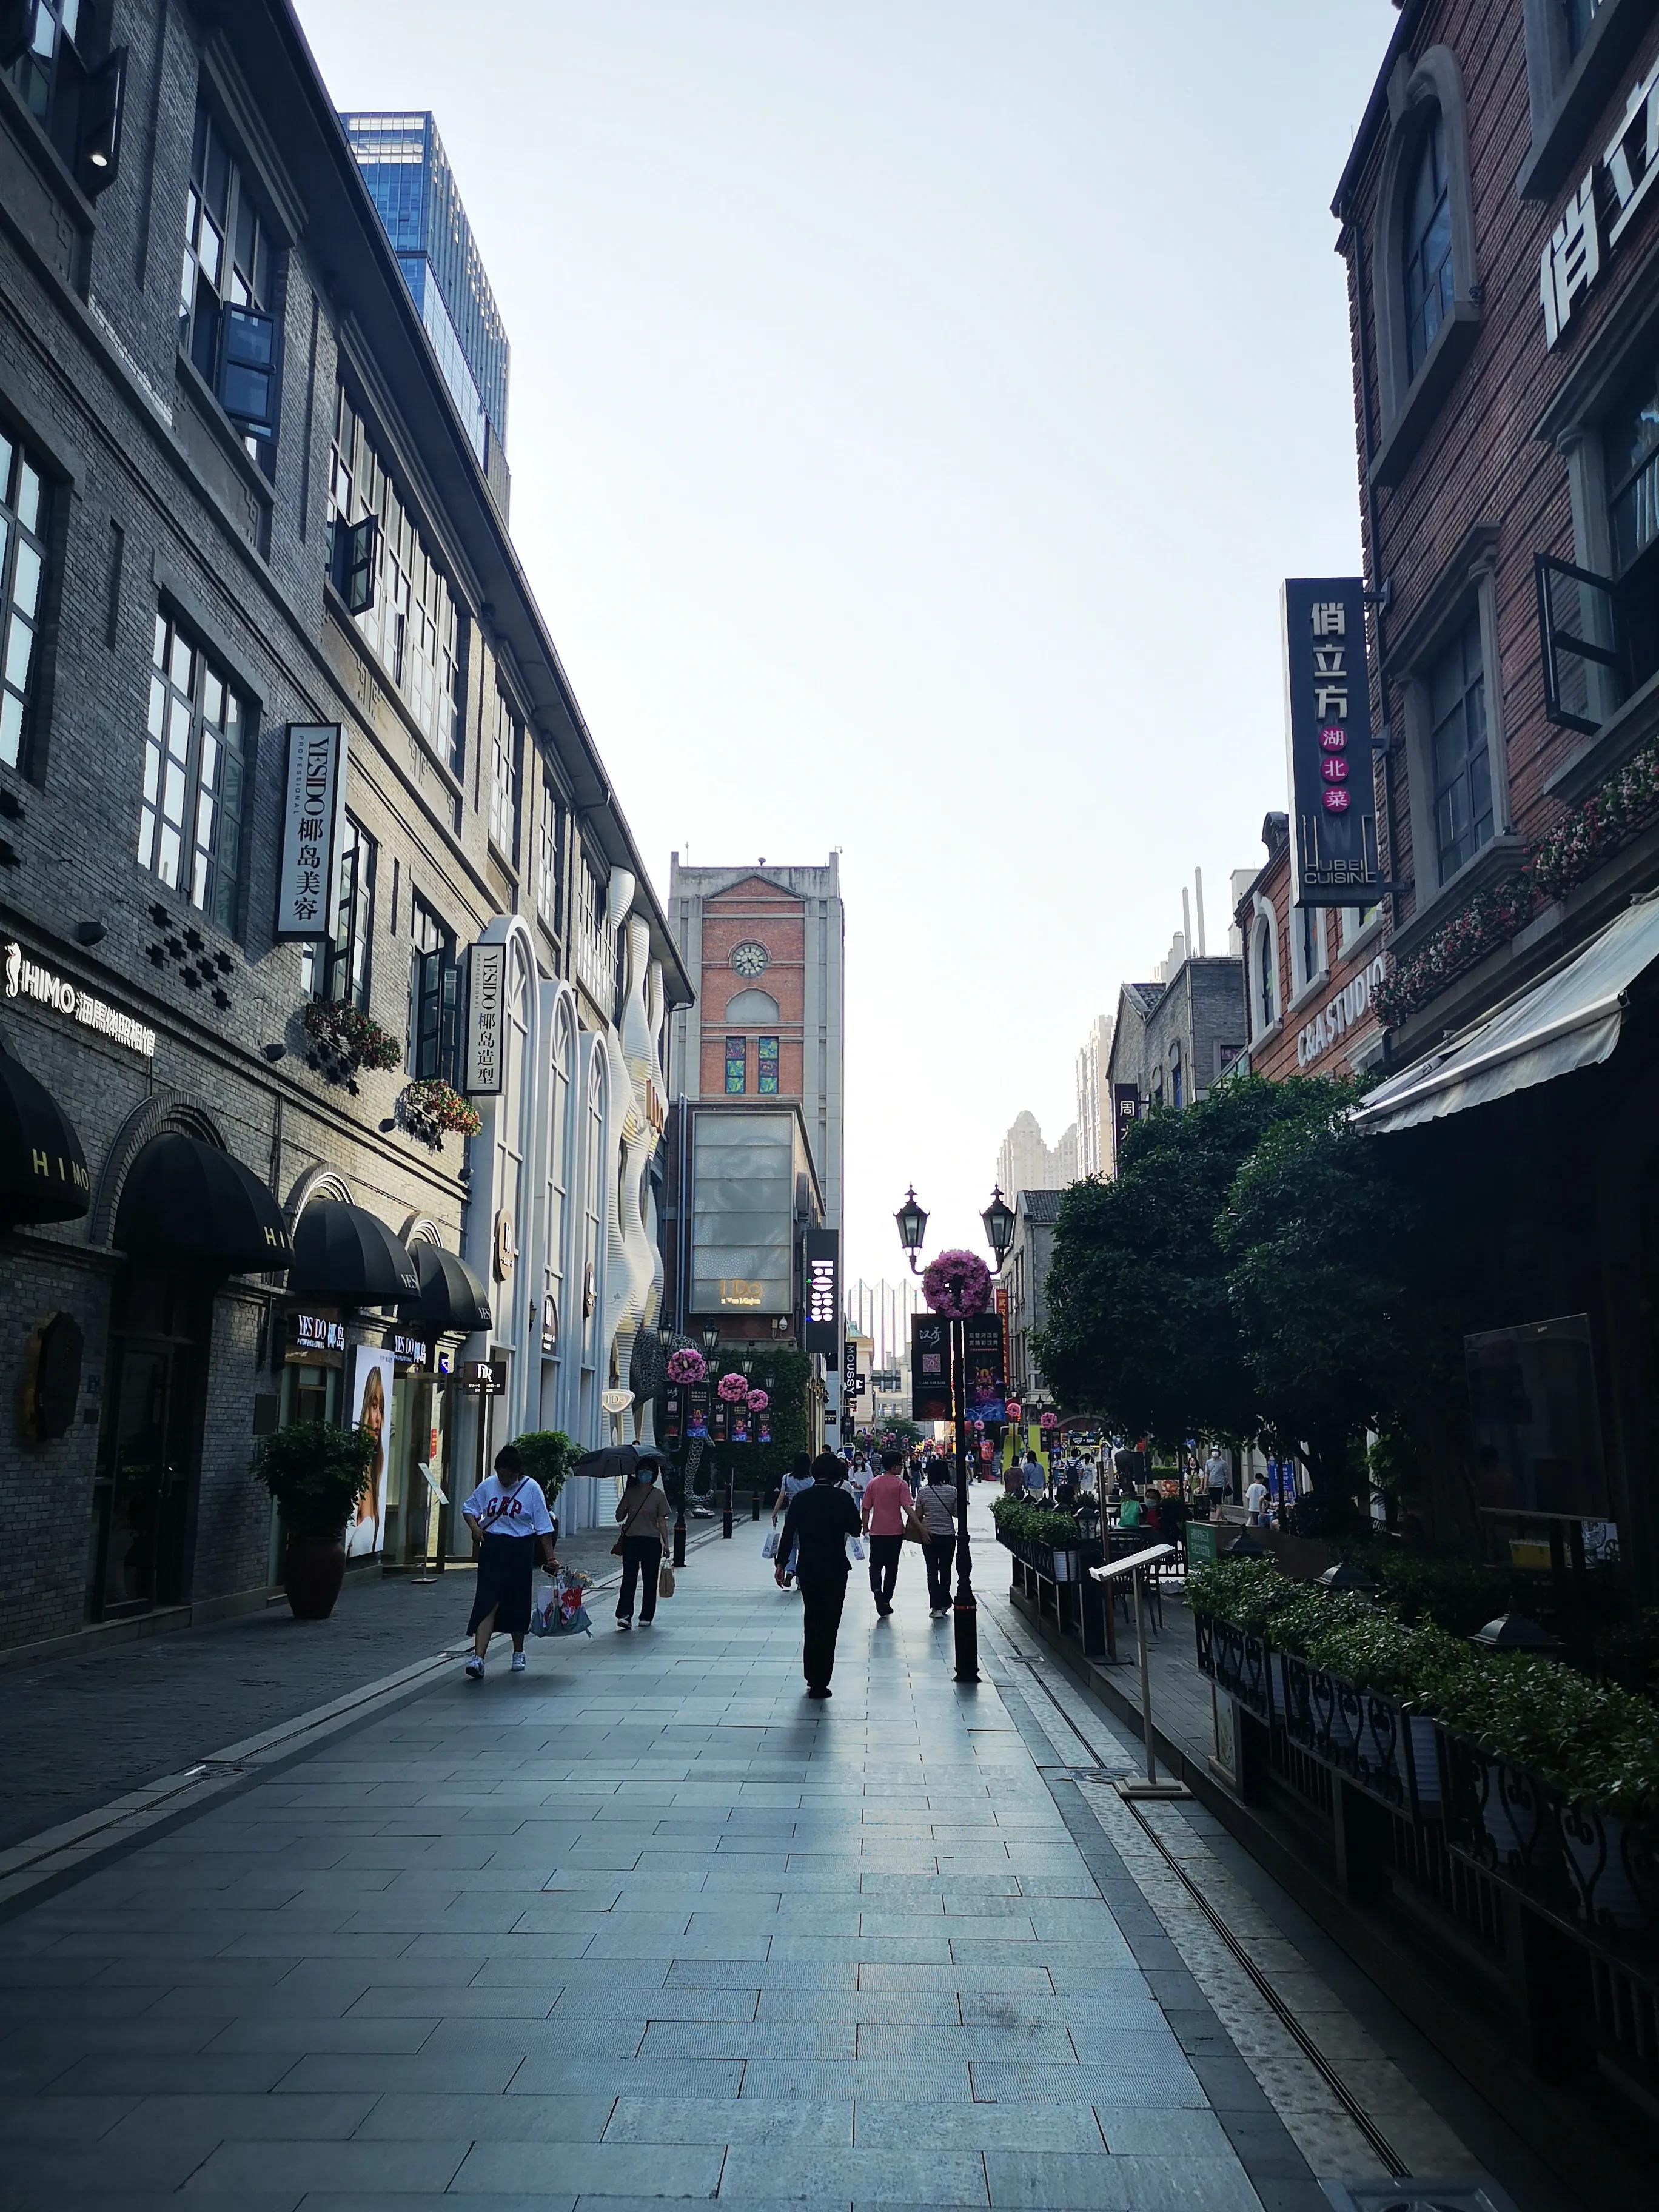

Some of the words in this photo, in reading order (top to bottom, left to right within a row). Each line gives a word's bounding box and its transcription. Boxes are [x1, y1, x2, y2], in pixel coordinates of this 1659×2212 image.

[1311, 602, 1348, 719] 俏立方
[293, 736, 304, 814] PROFESSIONAL
[1323, 731, 1348, 807] 湖北菜
[293, 817, 324, 920] 椰岛美容
[21, 960, 75, 1014] HIMO
[477, 1013, 495, 1084] 椰岛造型
[32, 1148, 89, 1191] HIMO
[401, 1274, 418, 1288] YES
[478, 1307, 491, 1319] YES
[606, 1395, 609, 1404] I
[487, 1496, 522, 1519] GAP
